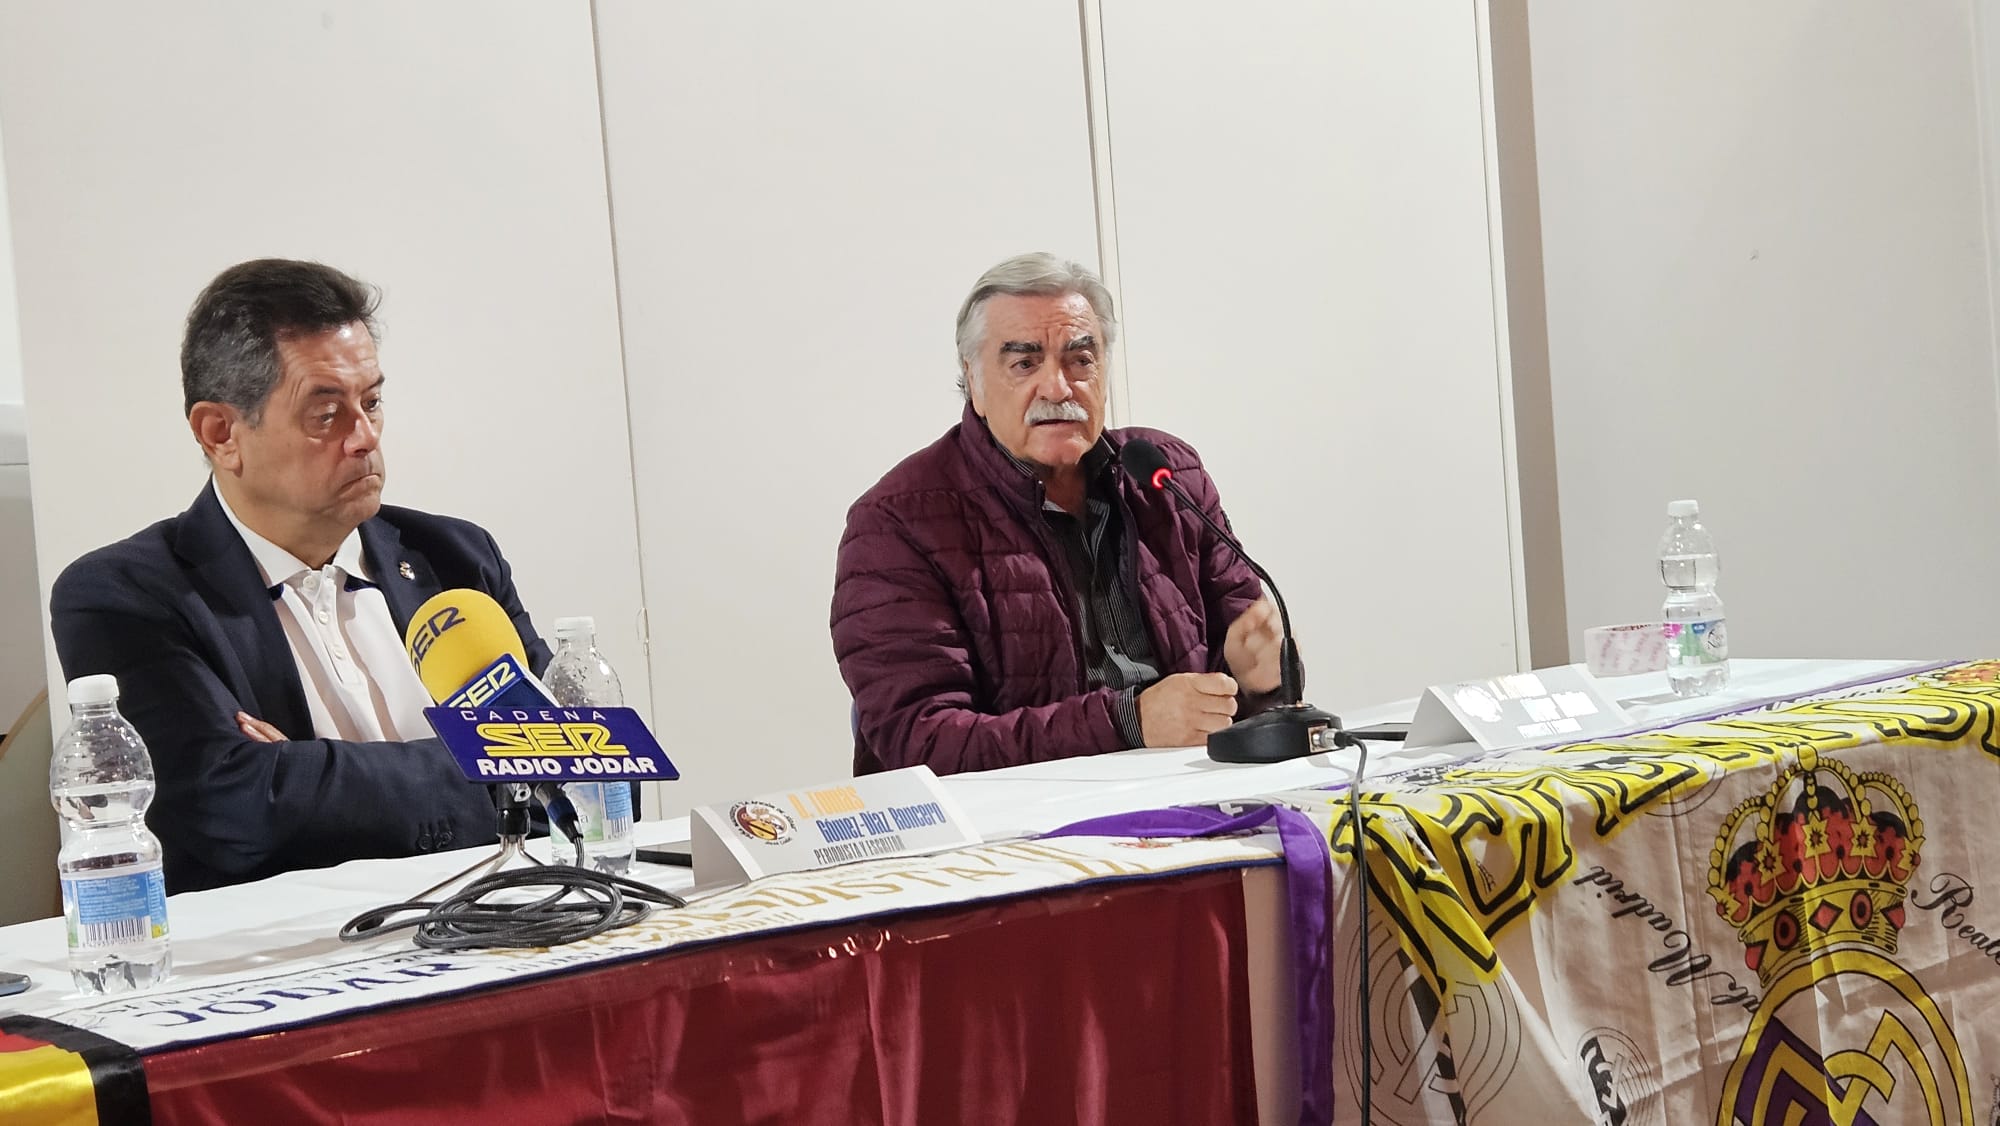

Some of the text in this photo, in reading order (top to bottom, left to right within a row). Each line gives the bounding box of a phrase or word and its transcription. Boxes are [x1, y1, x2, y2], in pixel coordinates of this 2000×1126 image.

[461, 710, 607, 721] CADENA
[476, 723, 630, 757] SER
[476, 757, 658, 776] RADIO JODAR
[887, 801, 947, 831] Roncero
[814, 835, 905, 865] PERIODISTA Y ESCRITOR
[1573, 866, 1736, 987] Madrid
